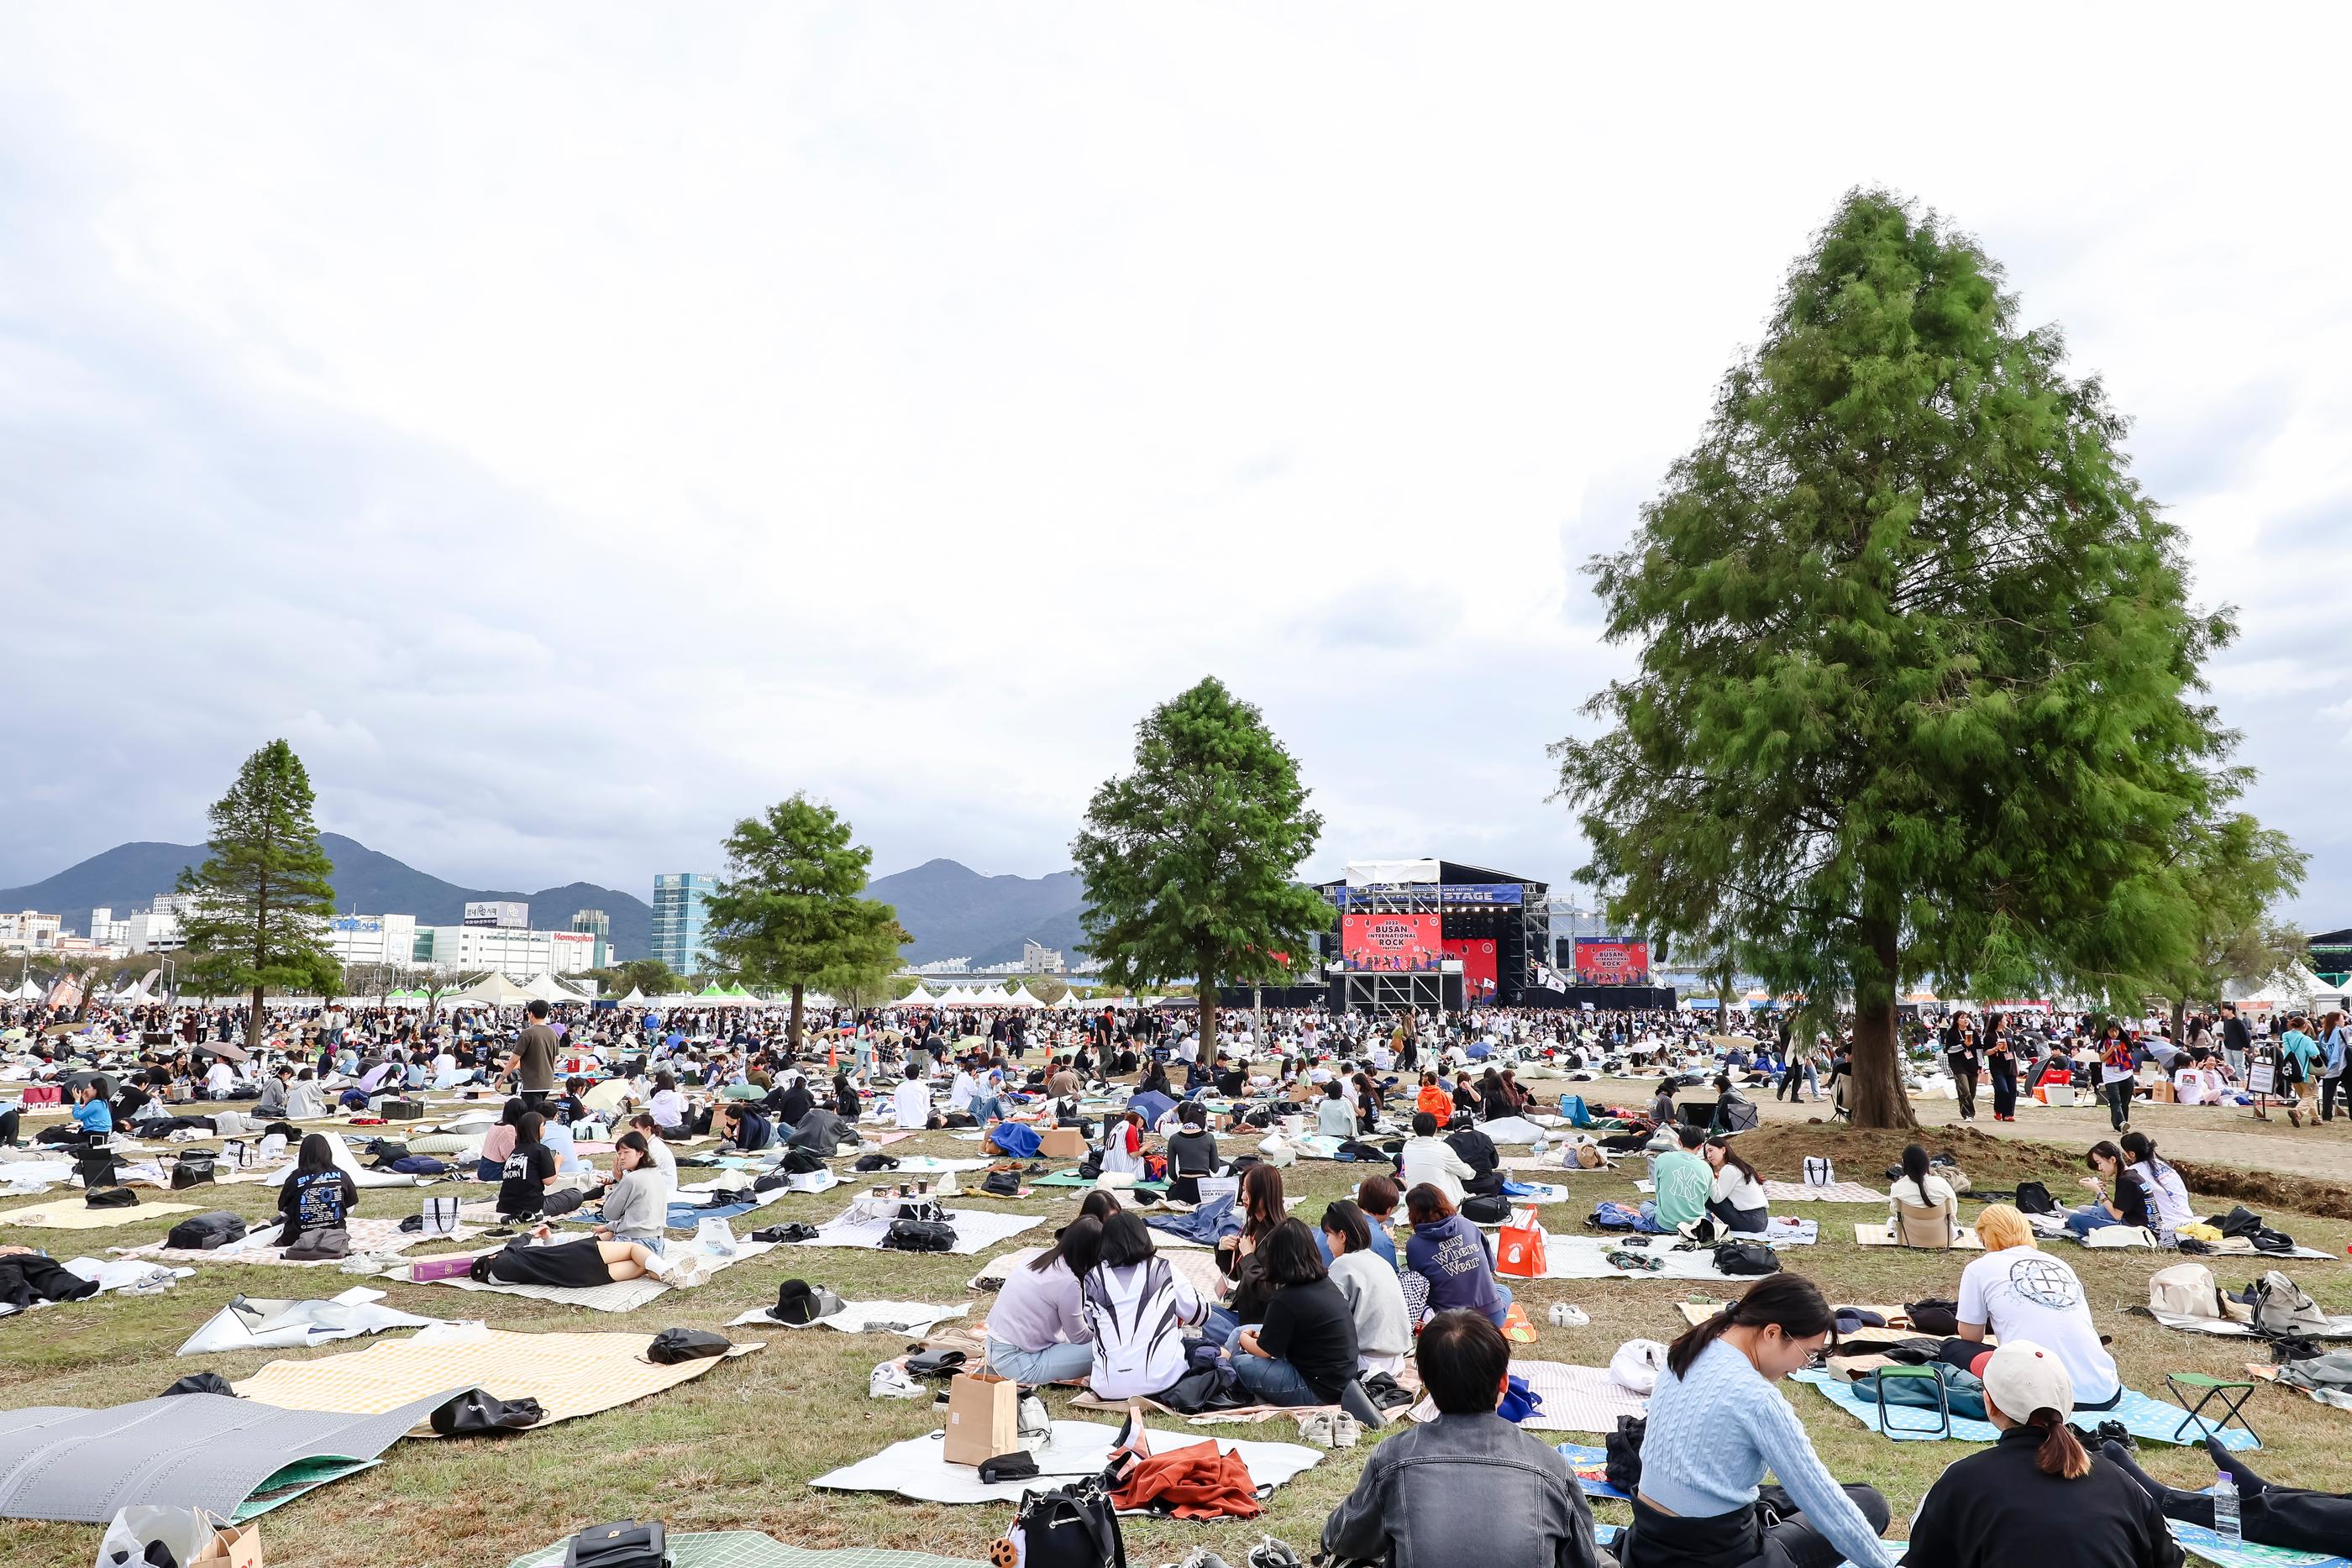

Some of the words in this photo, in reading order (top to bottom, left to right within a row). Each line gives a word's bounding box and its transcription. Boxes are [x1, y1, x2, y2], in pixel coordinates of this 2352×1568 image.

[1443, 892, 1493, 900] STAGE
[554, 932, 594, 942] Homeplus
[1438, 1234, 1464, 1251] any
[1431, 1243, 1480, 1266] Where
[1441, 1257, 1480, 1277] Wear
